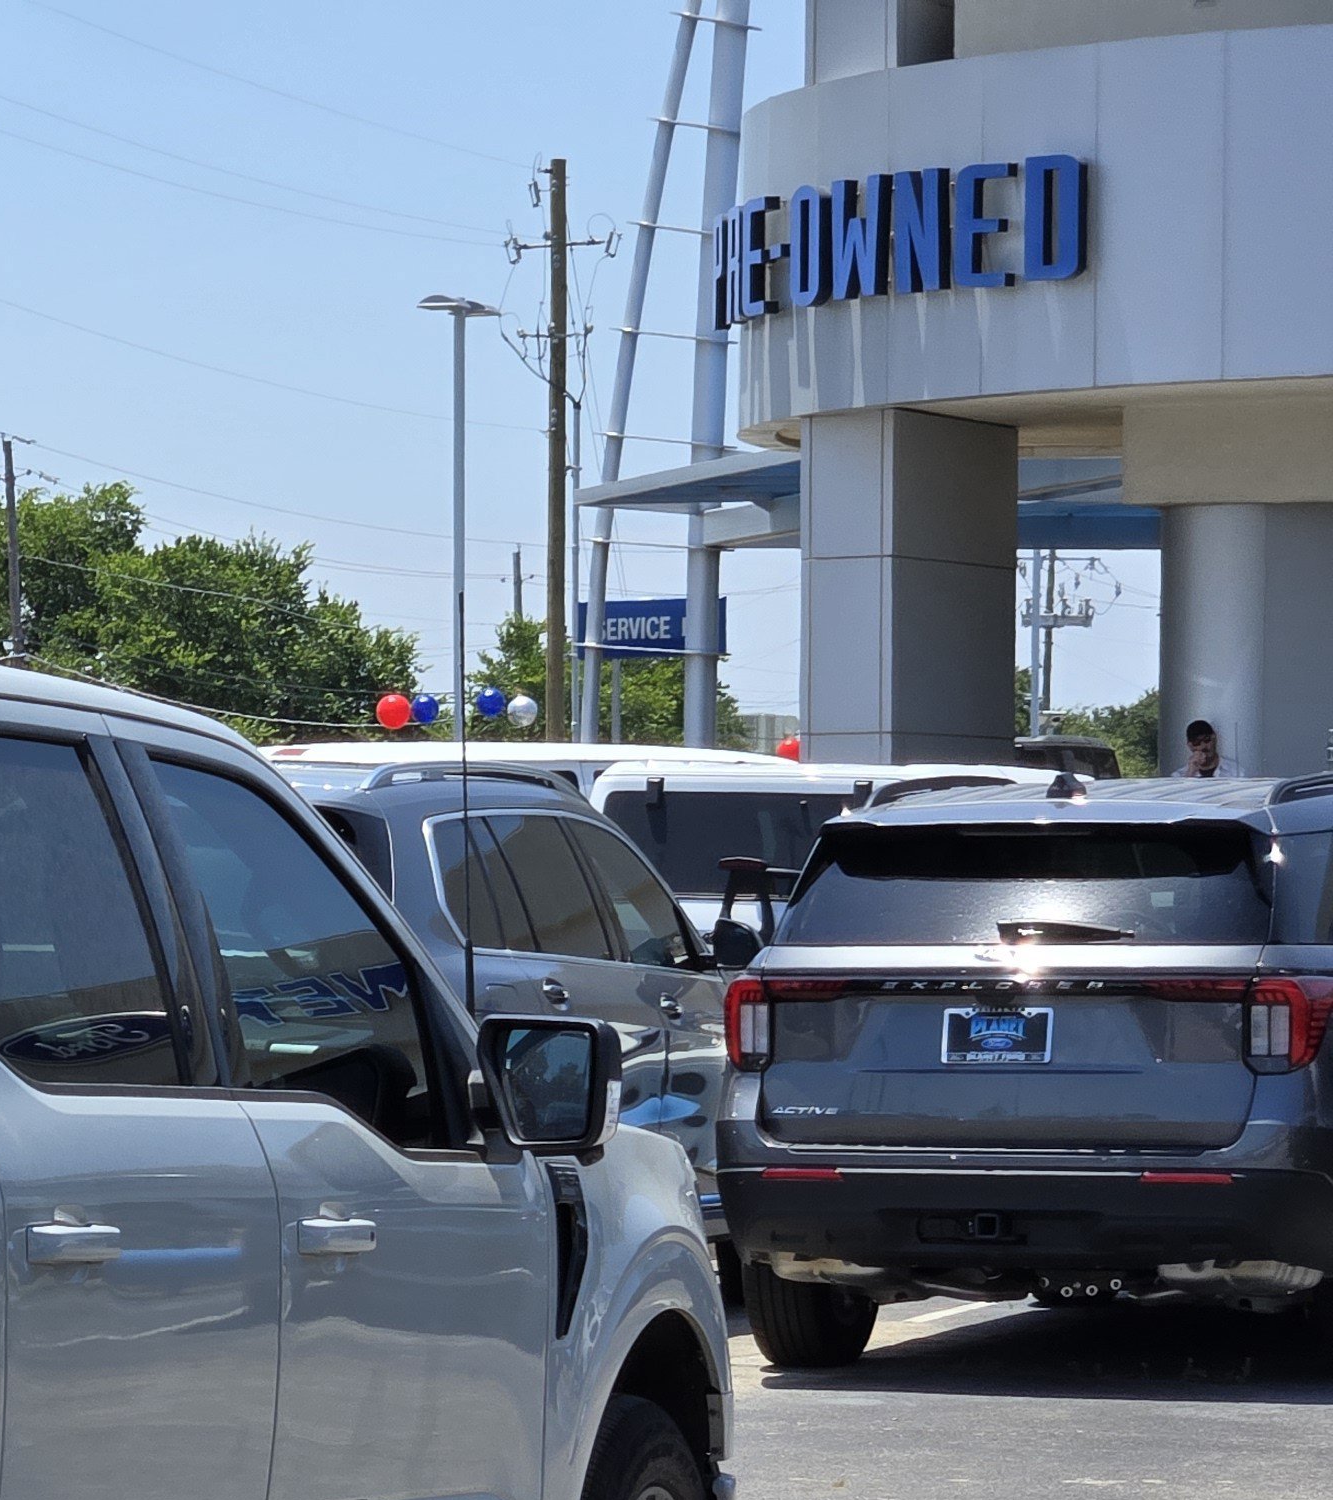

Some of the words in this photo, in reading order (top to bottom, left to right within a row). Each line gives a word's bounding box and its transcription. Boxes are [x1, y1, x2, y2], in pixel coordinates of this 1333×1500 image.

[713, 154, 1087, 330] PRE-OWNED
[880, 980, 1105, 991] EXPLORER
[771, 1106, 839, 1115] ACTIVE
